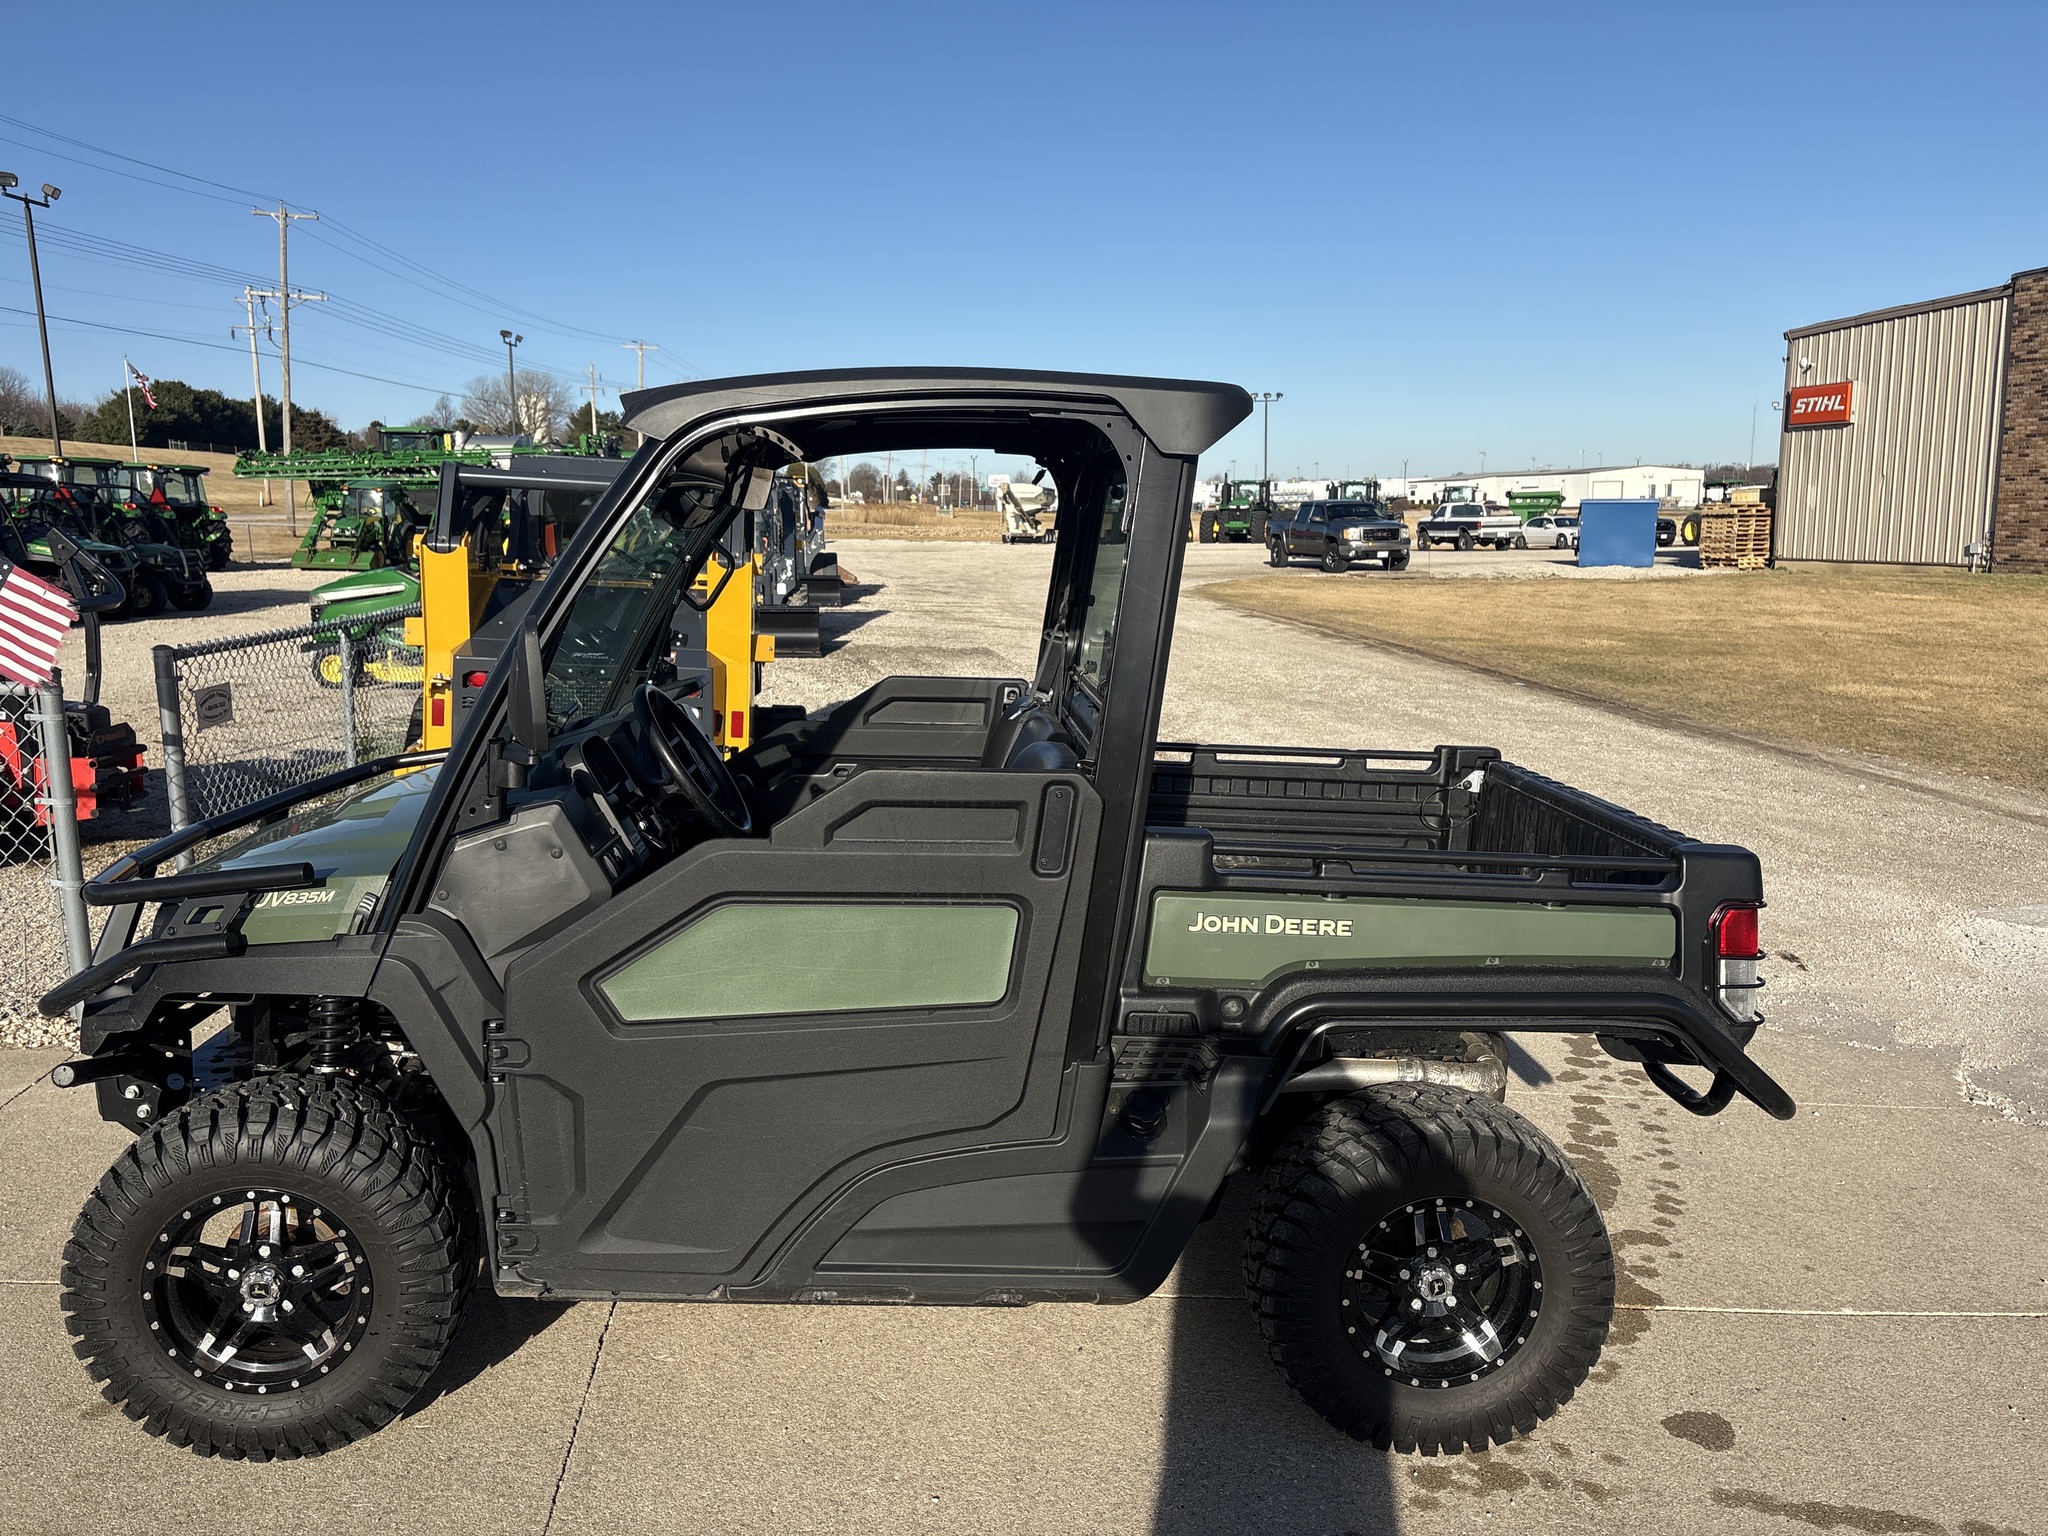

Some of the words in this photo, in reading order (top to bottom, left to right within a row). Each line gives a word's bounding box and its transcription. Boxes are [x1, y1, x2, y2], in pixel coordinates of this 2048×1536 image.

[1793, 394, 1845, 415] STIHL
[1187, 911, 1260, 934] JOHN
[1264, 913, 1354, 937] DEERE
